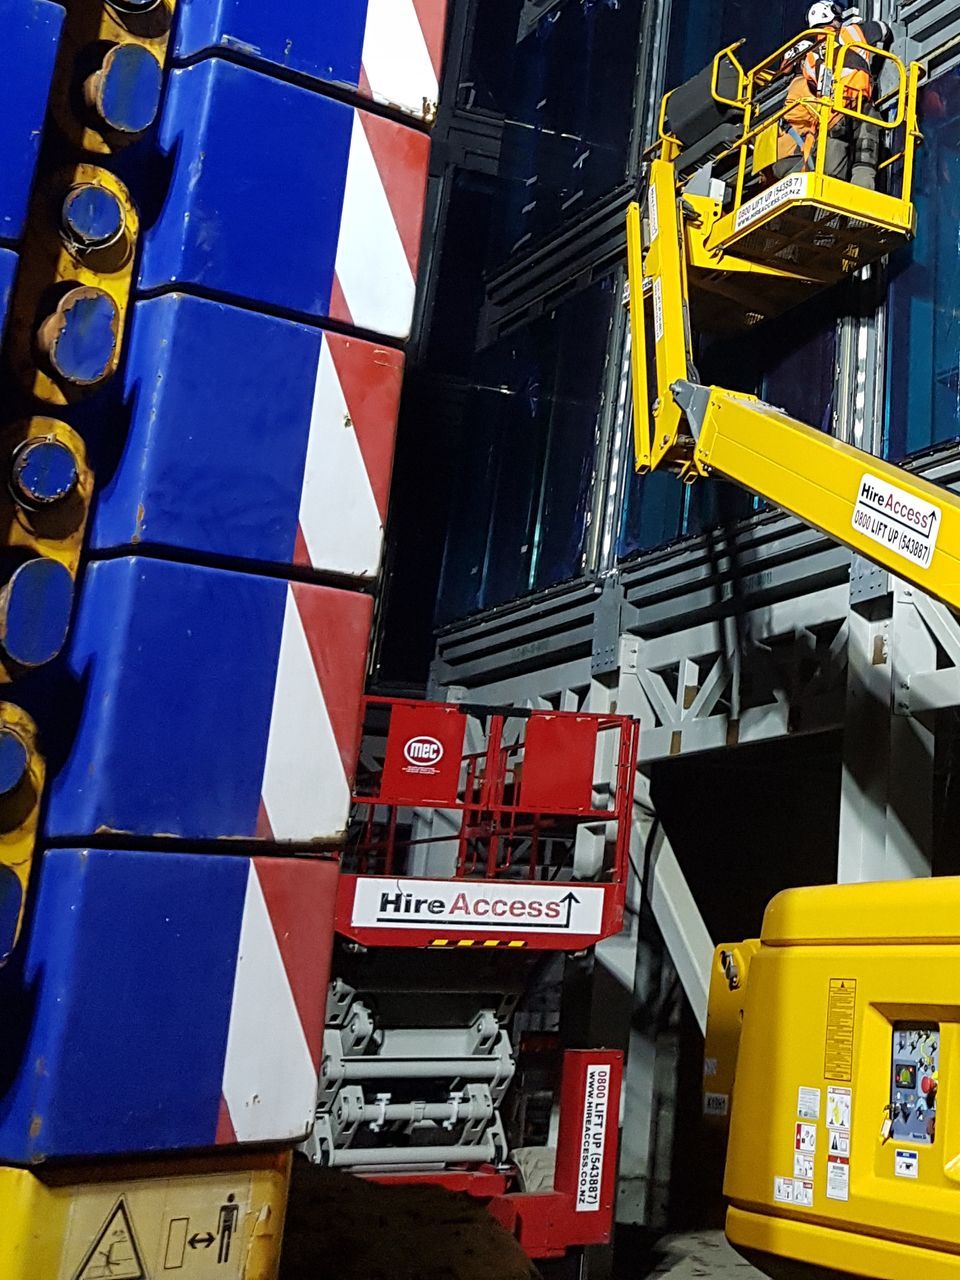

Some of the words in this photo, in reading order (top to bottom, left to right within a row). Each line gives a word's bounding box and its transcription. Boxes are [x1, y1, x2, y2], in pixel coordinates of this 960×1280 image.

[854, 509, 872, 530] 0800
[871, 518, 888, 539] LIFT
[887, 527, 899, 544] UP
[898, 530, 931, 565] (543887)
[596, 1070, 607, 1099] 0800
[594, 1102, 605, 1128] LIFT
[578, 1070, 596, 1204] WWW.HIREACCESS.CO.NZ
[592, 1132, 603, 1149] UP
[586, 1152, 602, 1205] (543887)
